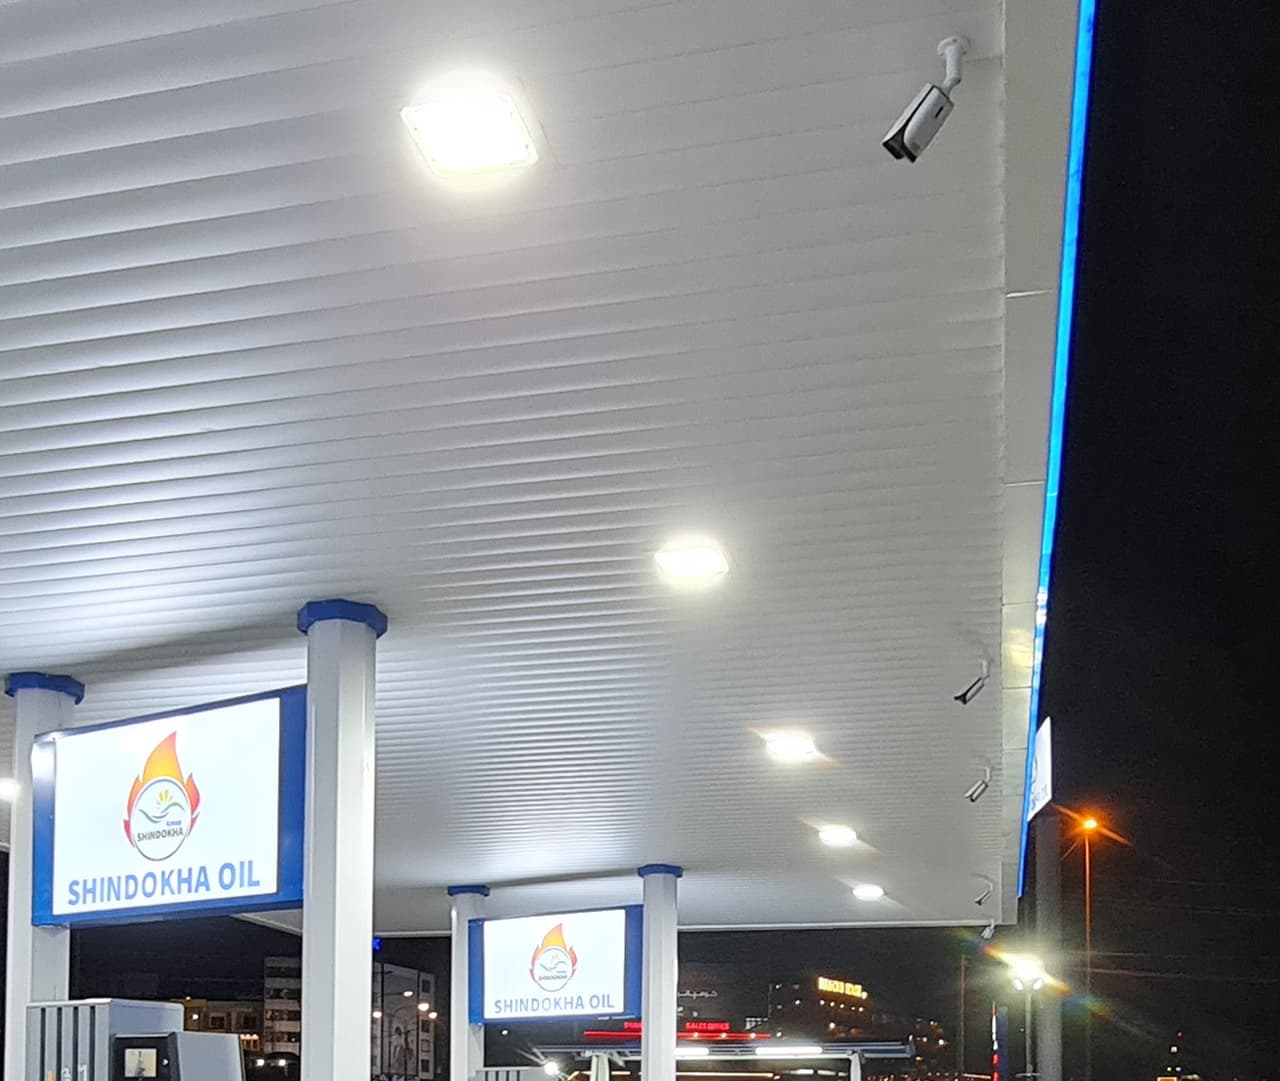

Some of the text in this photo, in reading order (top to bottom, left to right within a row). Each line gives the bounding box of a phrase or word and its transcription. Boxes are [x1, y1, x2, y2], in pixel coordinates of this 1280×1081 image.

[67, 860, 261, 906] SHINDOKHA OIL
[494, 994, 616, 1014] SHINDOKHA OIL
